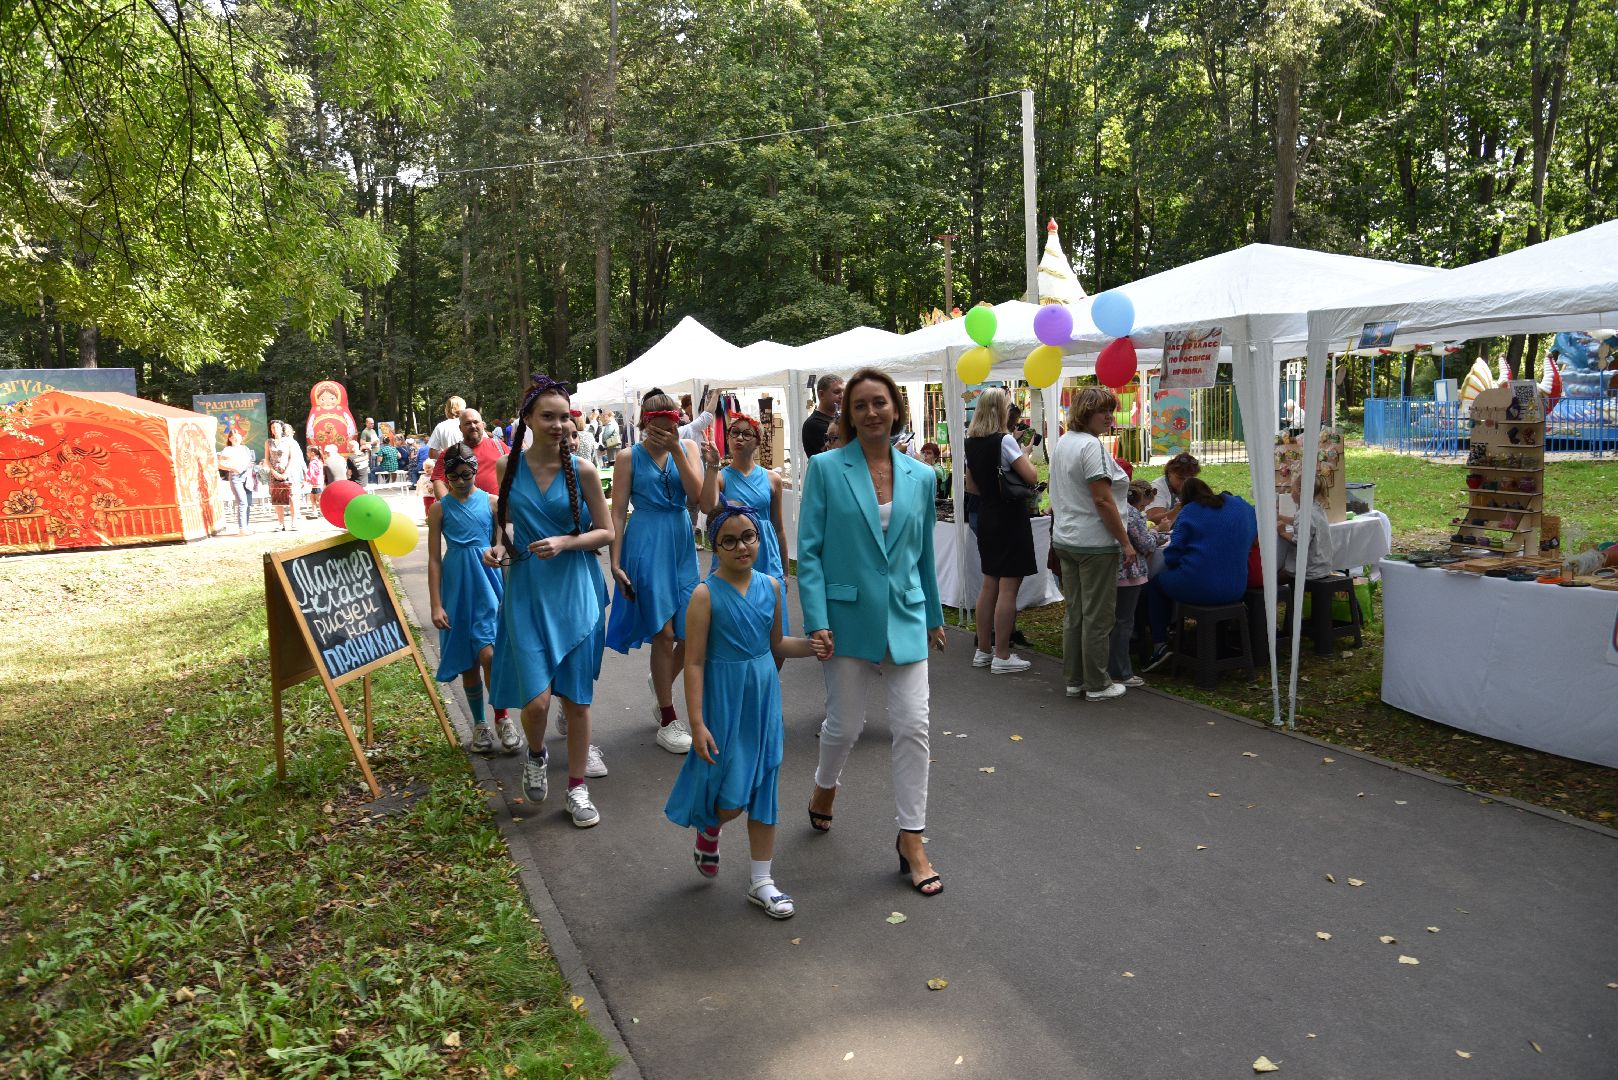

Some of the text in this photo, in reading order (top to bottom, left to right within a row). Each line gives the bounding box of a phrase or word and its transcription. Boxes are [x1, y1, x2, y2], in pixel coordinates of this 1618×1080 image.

[1168, 356, 1178, 364] ПО
[292, 549, 373, 607] Мастер
[345, 619, 376, 639] на
[323, 621, 405, 677] ПРЯНИКАХ
